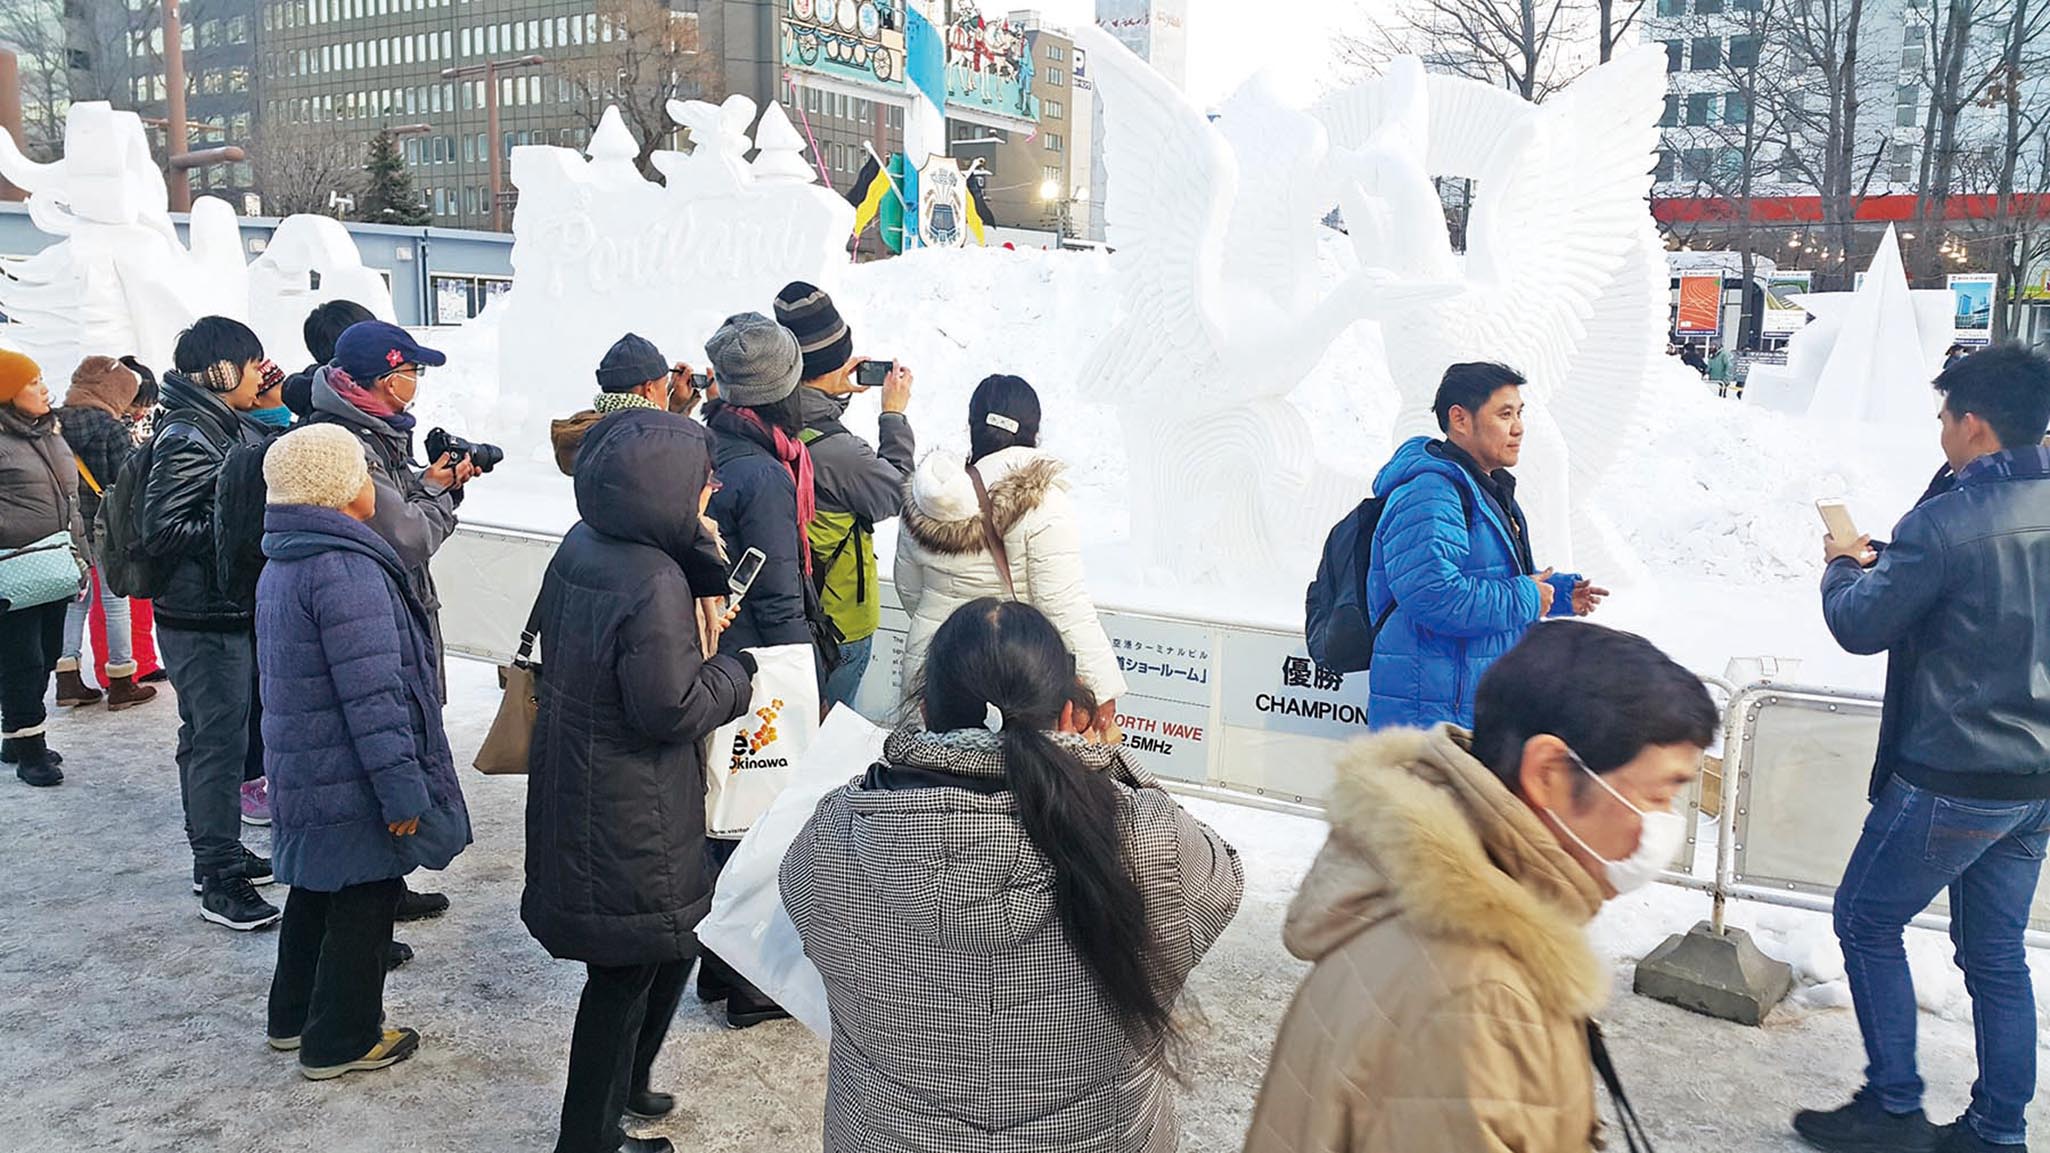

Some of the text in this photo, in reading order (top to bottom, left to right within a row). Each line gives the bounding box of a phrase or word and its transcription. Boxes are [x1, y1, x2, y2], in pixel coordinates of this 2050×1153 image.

[1282, 655, 1344, 692] 優勝
[1255, 693, 1369, 725] CHAMPION
[1162, 722, 1203, 741] WAVE
